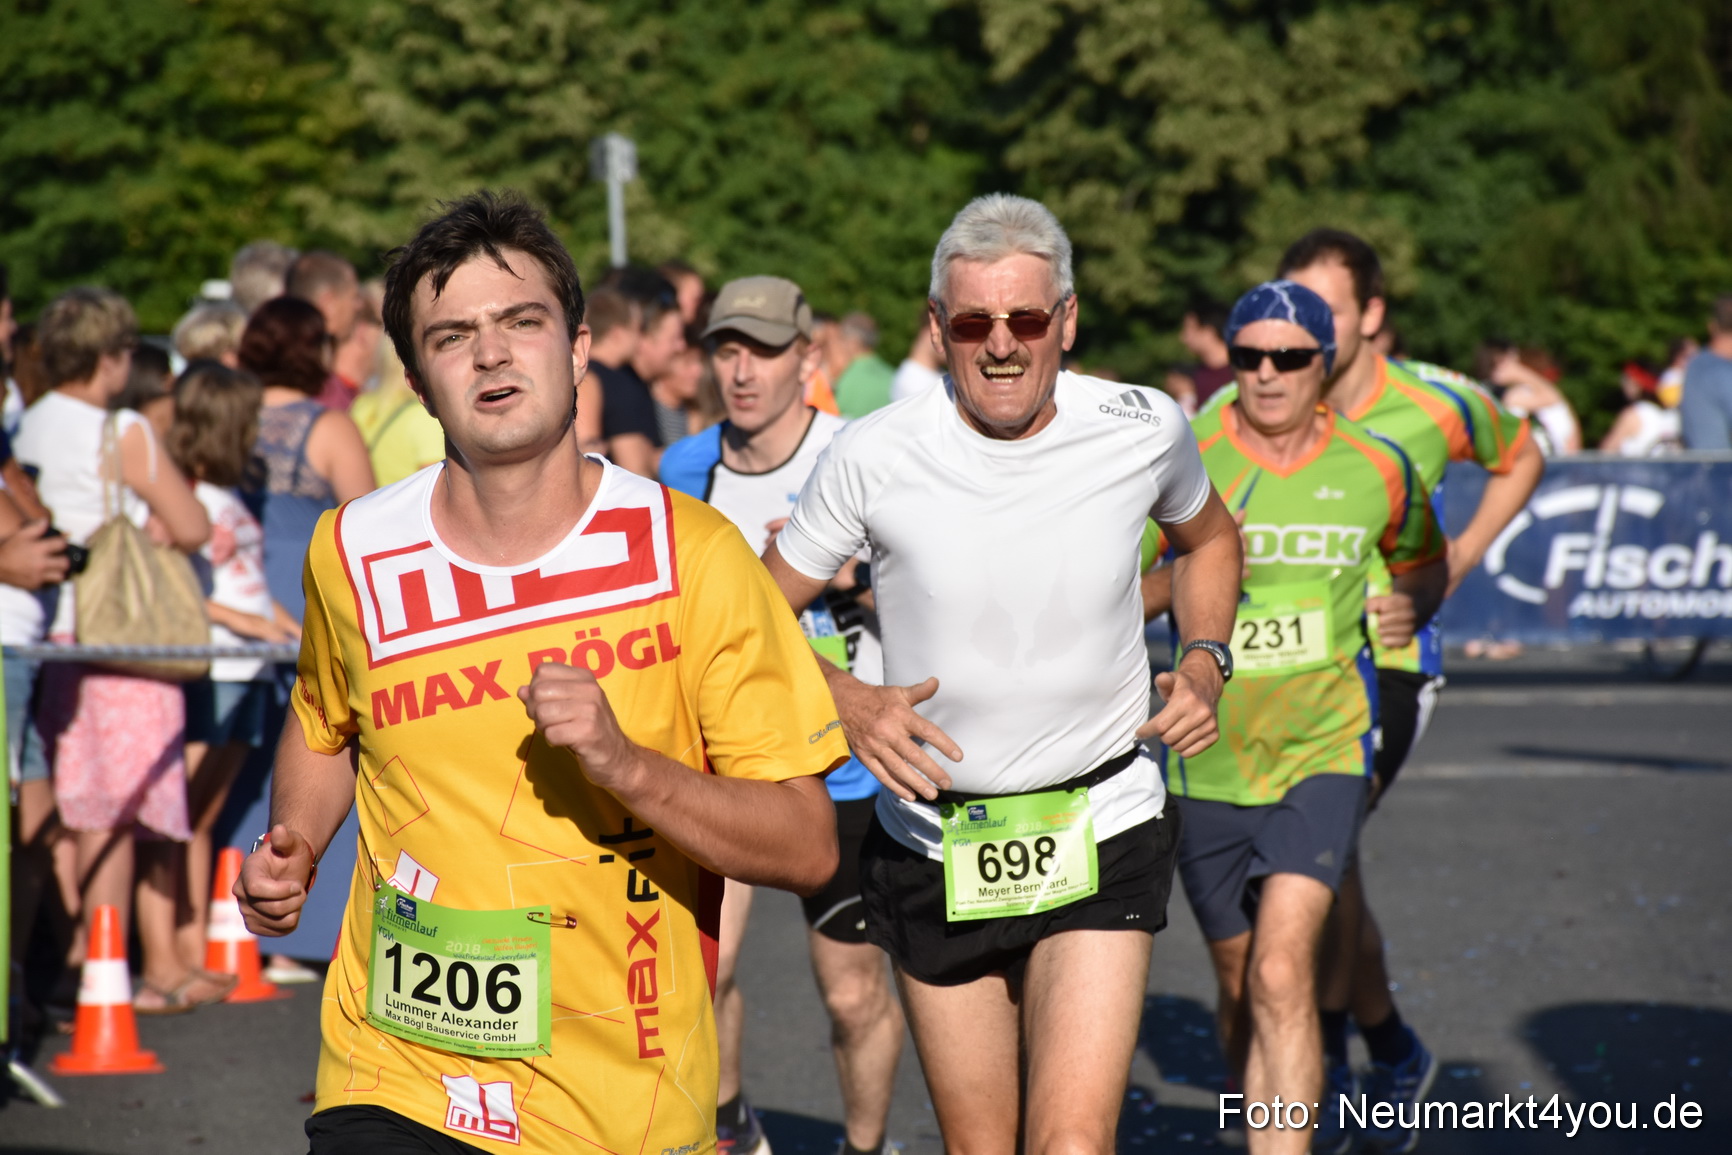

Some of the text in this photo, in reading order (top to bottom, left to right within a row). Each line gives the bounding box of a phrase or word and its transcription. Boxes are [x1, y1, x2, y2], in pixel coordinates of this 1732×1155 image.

[1099, 403, 1162, 427] adidas
[1241, 524, 1367, 565] OCK
[1545, 492, 1732, 590] Fisch
[1568, 590, 1732, 619] AUTOMO
[1241, 616, 1303, 650] 231
[371, 659, 511, 731] MAX
[977, 836, 1060, 884] 698
[978, 887, 1012, 899] Meyer
[387, 908, 439, 938] firmenlauf
[445, 940, 481, 955] 2018
[385, 942, 522, 1015] 1206
[385, 993, 437, 1020] Lummer
[441, 1011, 519, 1031] Alexander
[385, 1008, 402, 1023] Max
[404, 1016, 424, 1030] Bögl
[426, 1022, 480, 1041] Bauservice
[483, 1032, 516, 1042] GmbH
